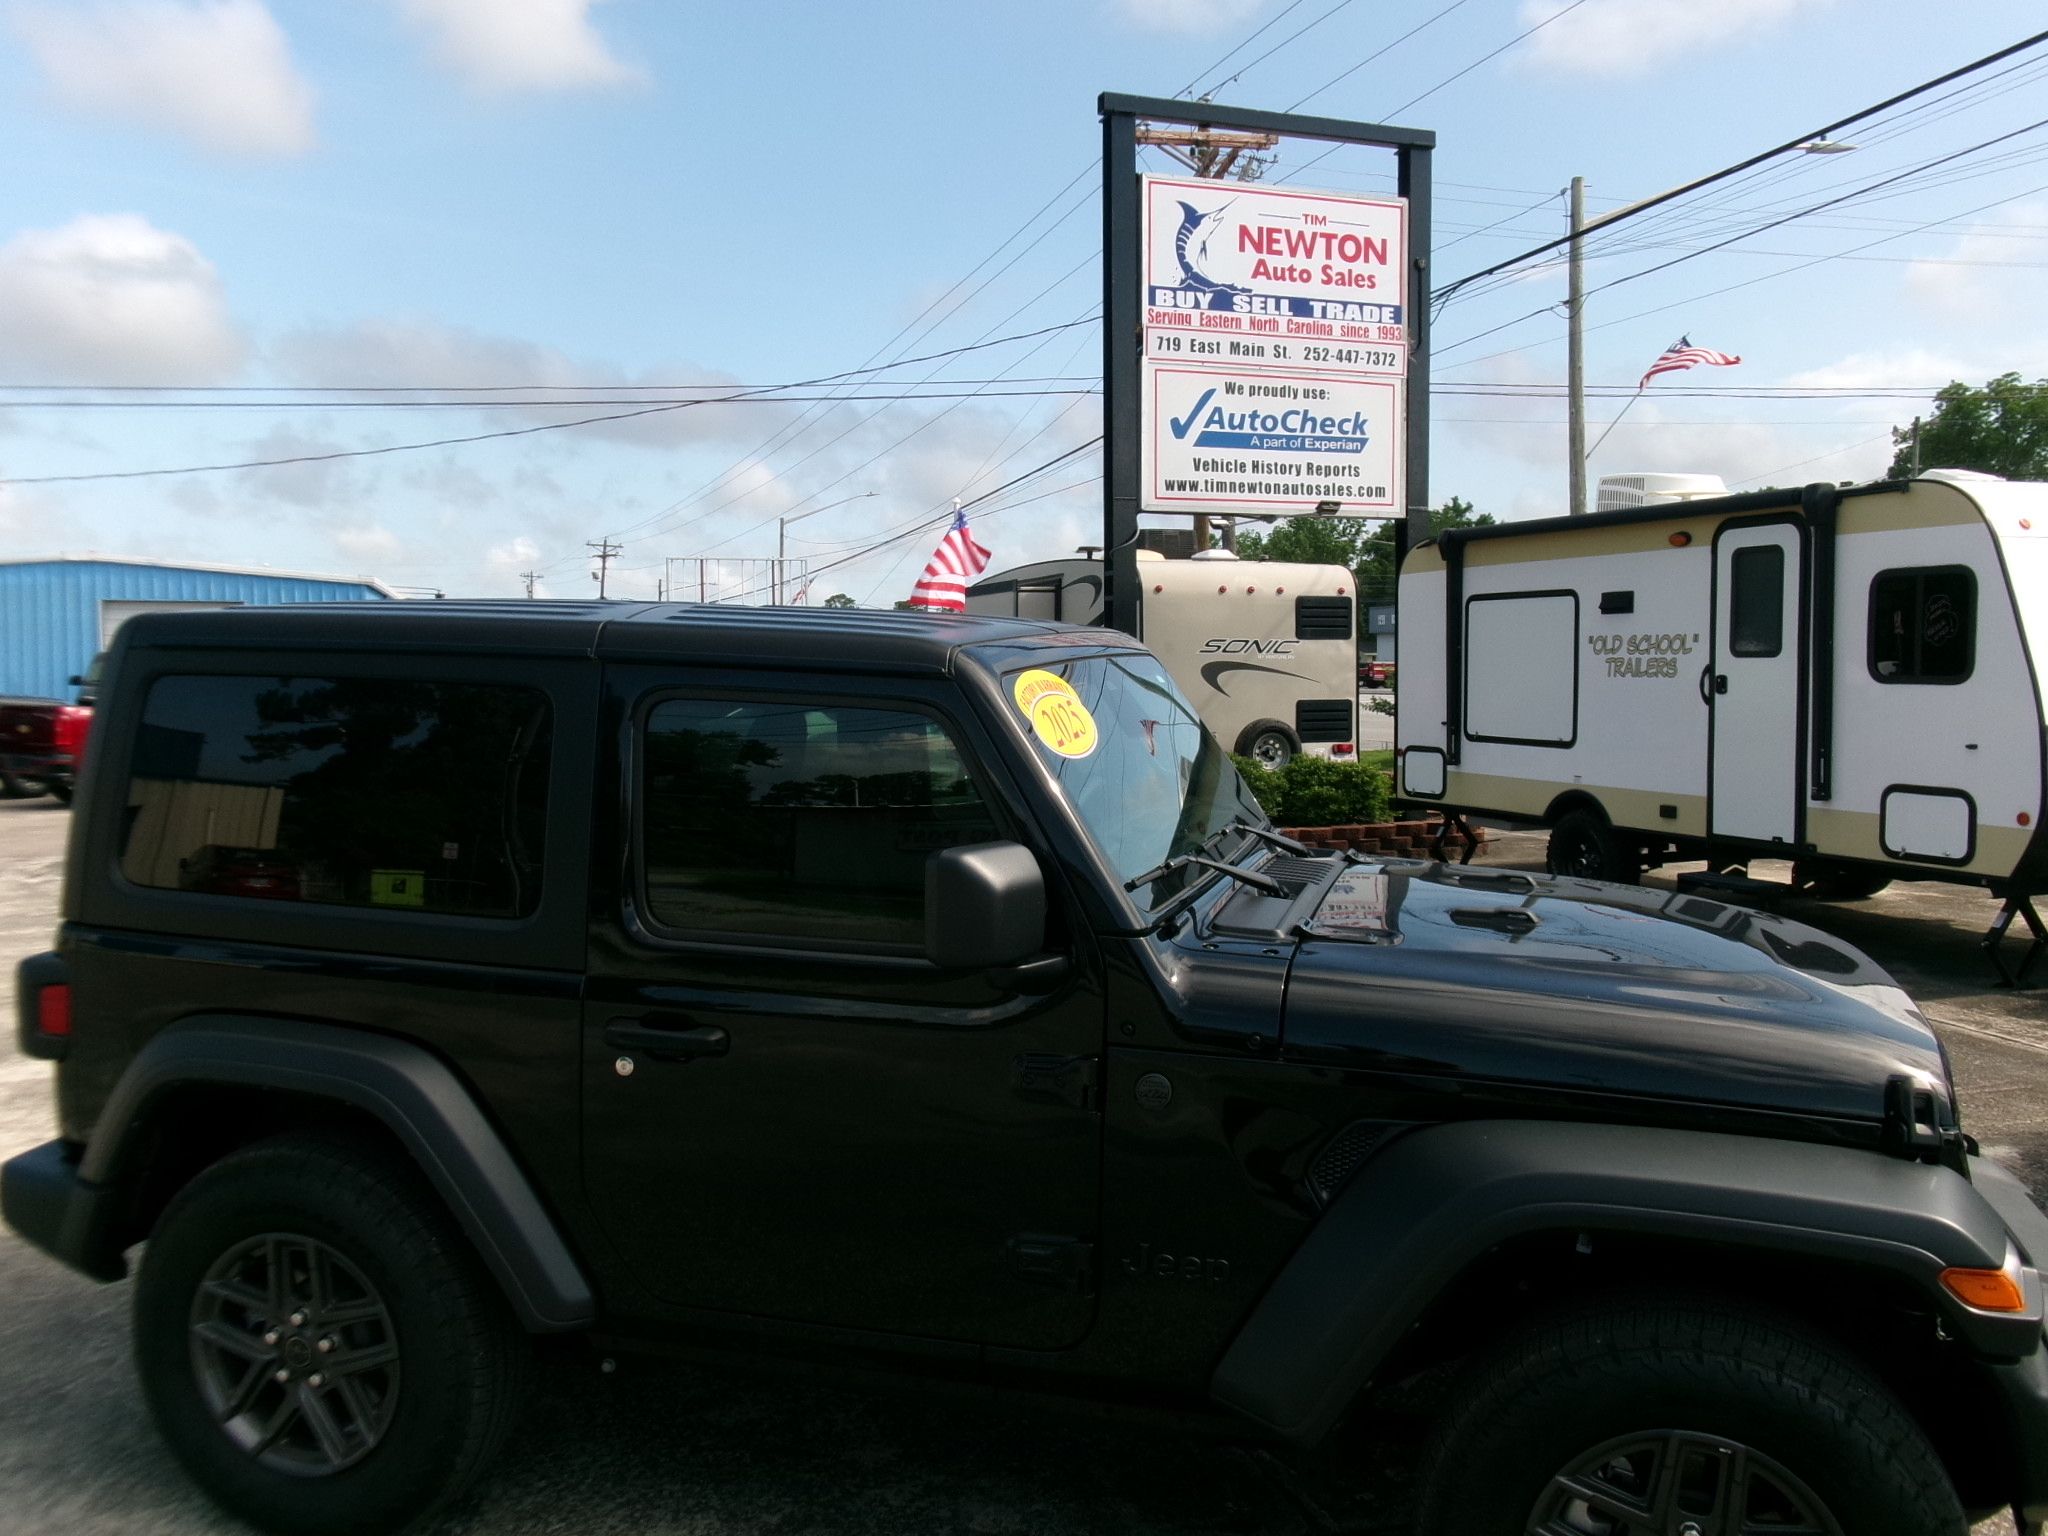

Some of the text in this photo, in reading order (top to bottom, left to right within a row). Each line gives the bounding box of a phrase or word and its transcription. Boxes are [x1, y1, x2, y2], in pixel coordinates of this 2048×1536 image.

[1302, 213, 1327, 227] TIM
[1238, 224, 1388, 266] NEWTON
[1251, 258, 1377, 289] Auto Sales
[1155, 289, 1396, 324] BUY SELL TRADE
[1147, 309, 1402, 340] Serving Eastern North Carolina since 1993
[1156, 336, 1396, 367] 719 East Main St. 252-447-7372
[1225, 381, 1330, 401] We proudly use:
[1203, 406, 1369, 436] AutoCheck
[1250, 436, 1361, 452] A part of Experian
[1193, 457, 1361, 478] Vehicle History Reports
[1164, 479, 1386, 498] www.timnewtonautosales.com
[1198, 638, 1300, 655] SONIC
[1605, 657, 1678, 678] TRAILERS
[1041, 700, 1087, 748] 2025
